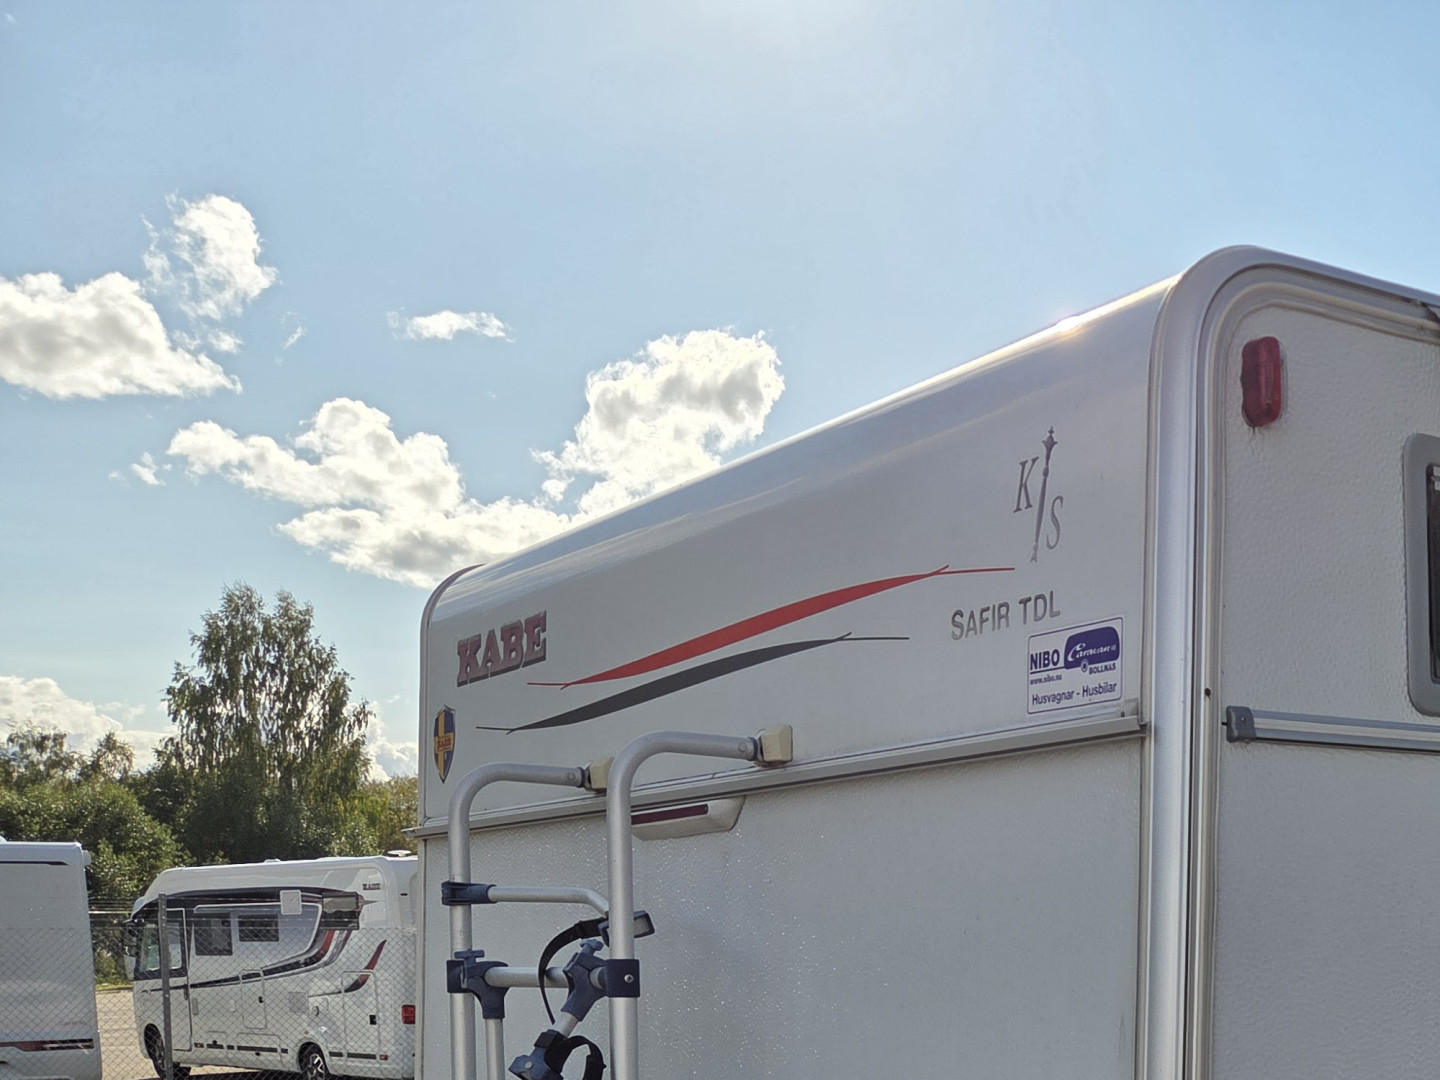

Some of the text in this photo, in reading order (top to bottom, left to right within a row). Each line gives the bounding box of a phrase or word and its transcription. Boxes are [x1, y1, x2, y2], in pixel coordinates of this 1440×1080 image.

[1013, 456, 1040, 513] K
[951, 590, 1062, 641] SAFIR TDL
[457, 609, 547, 688] KABE
[1030, 648, 1060, 671] NIBO
[1032, 690, 1075, 706] Husvagnar
[1082, 682, 1117, 698] Husbilar
